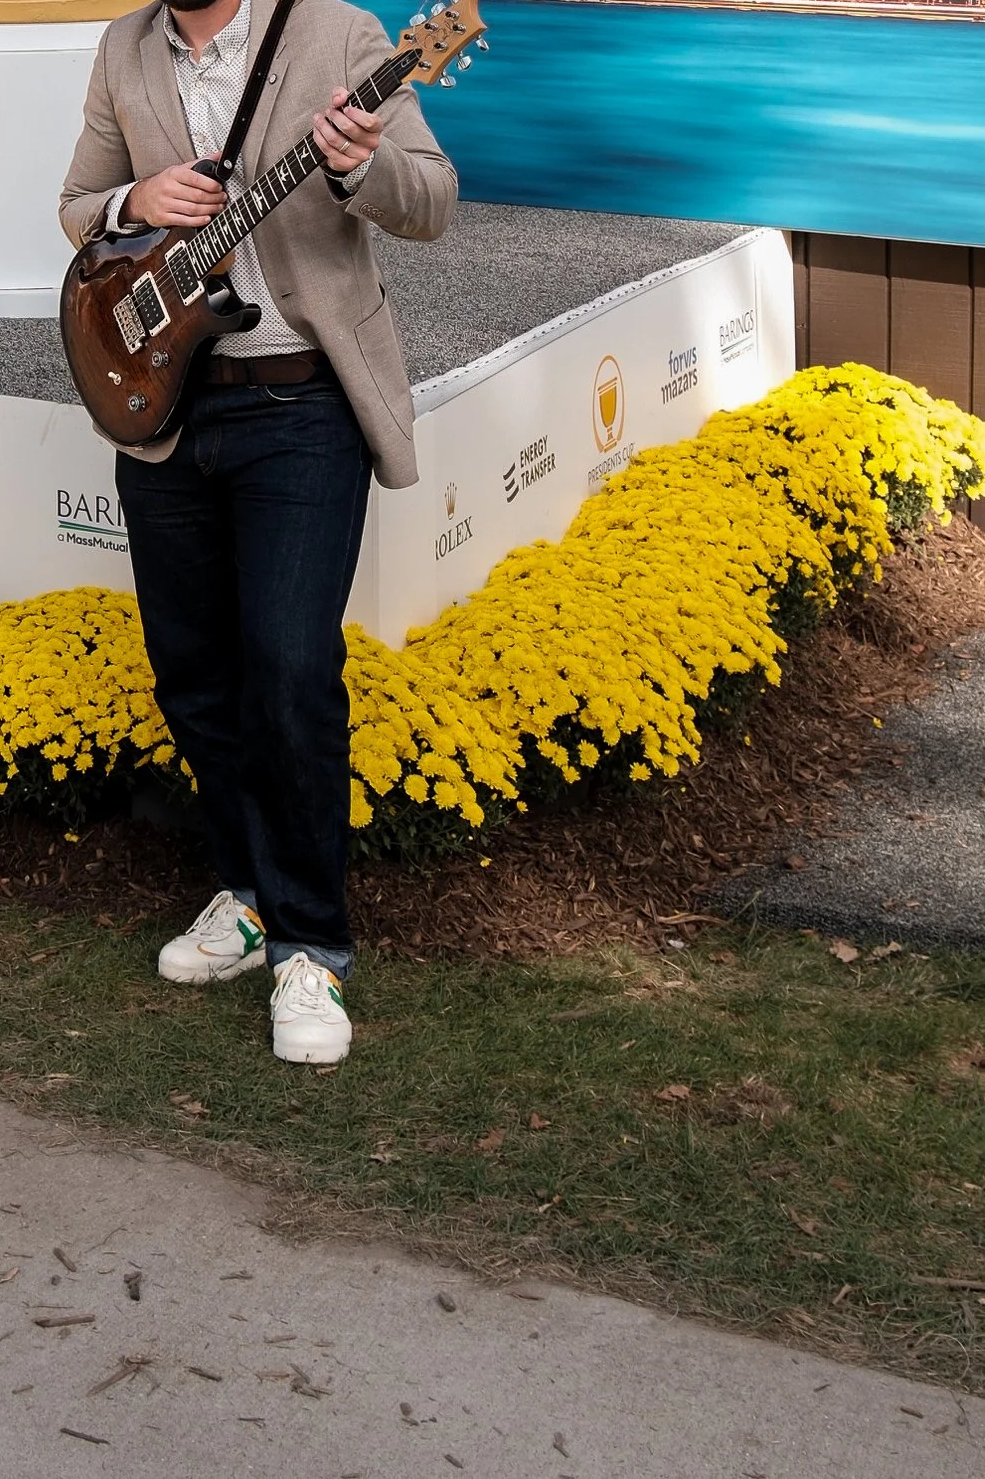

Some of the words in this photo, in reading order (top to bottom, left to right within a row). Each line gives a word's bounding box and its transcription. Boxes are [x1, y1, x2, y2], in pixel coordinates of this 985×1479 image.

[668, 347, 698, 378] forvis
[661, 368, 698, 405] mazars
[520, 435, 548, 468] ENERGY
[587, 450, 622, 486] PRESIDENTS
[622, 442, 634, 461] CUP
[521, 453, 556, 490] TRANSFER
[57, 489, 127, 528] BARI
[57, 533, 65, 542] a
[66, 532, 129, 553] MassMutual
